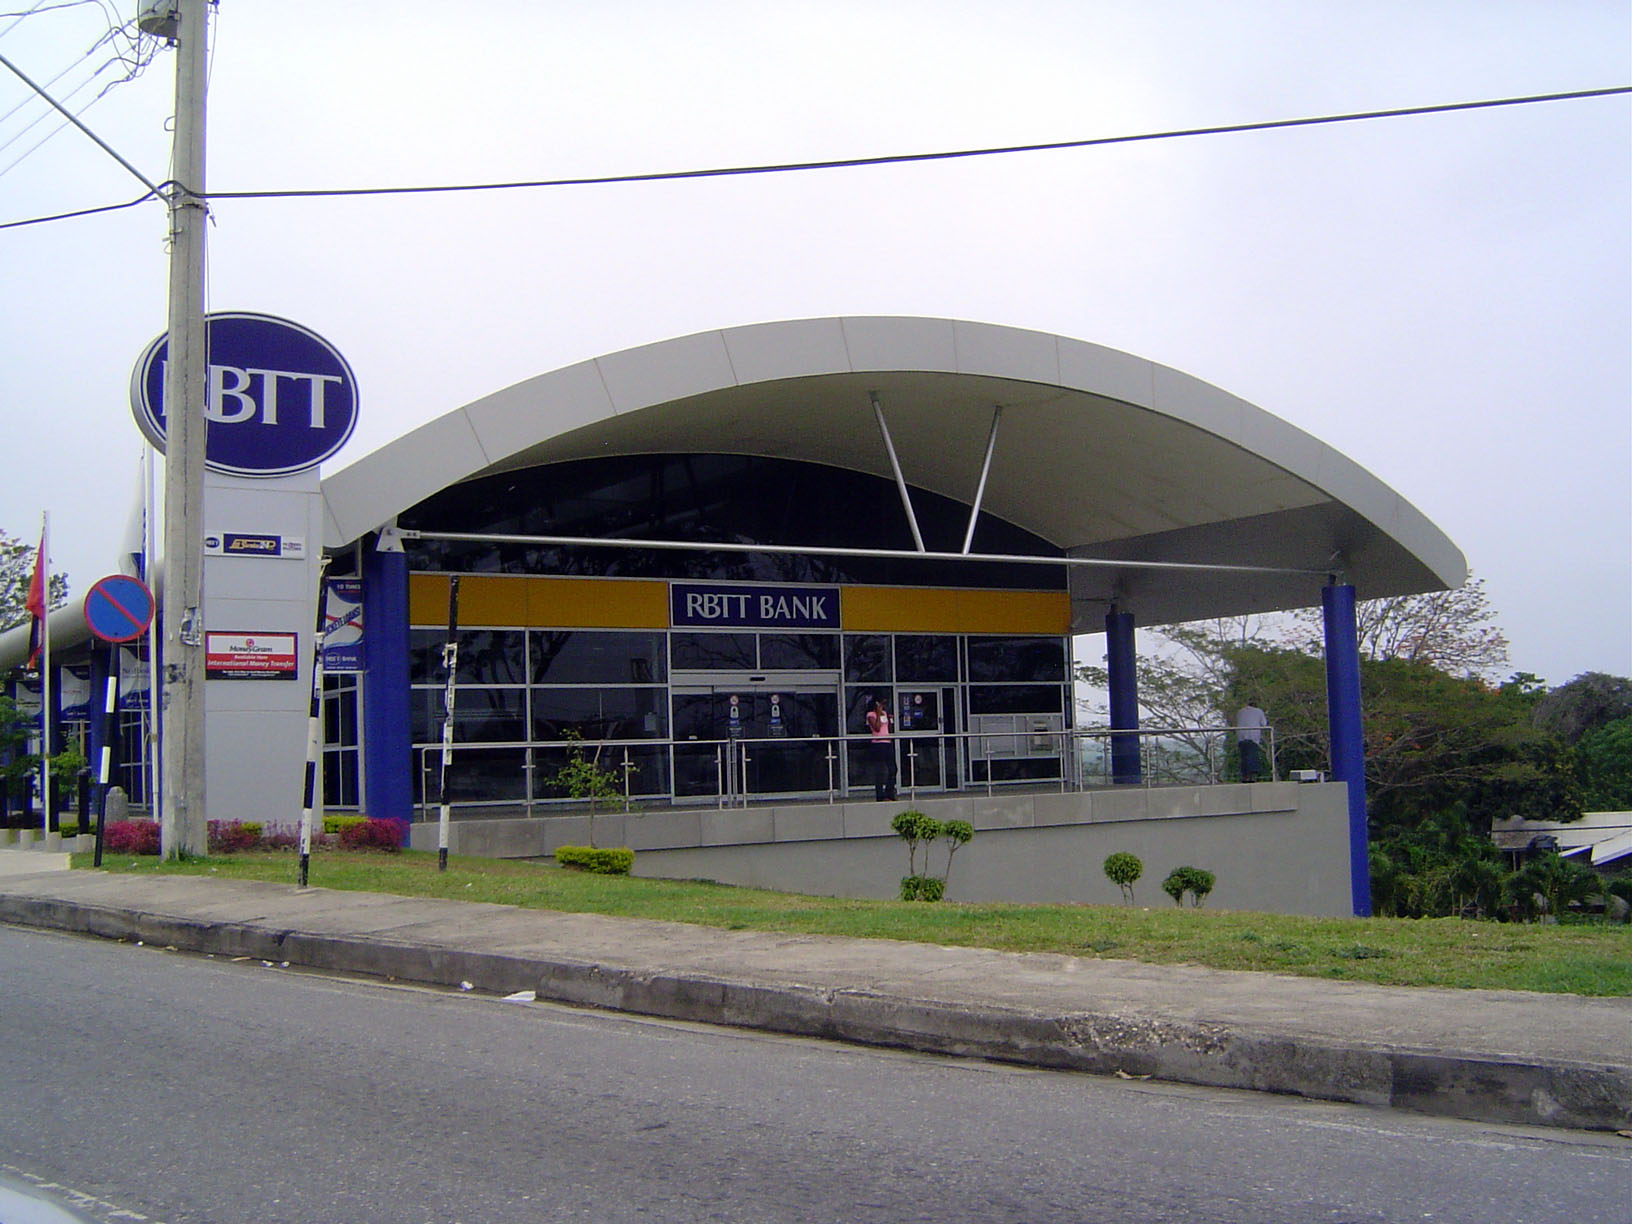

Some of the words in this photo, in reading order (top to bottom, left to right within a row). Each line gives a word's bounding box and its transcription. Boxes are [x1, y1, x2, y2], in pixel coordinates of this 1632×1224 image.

[686, 593, 752, 619] RBTT
[759, 595, 828, 620] BANK
[249, 660, 270, 668] Money
[271, 660, 295, 668] Transfer
